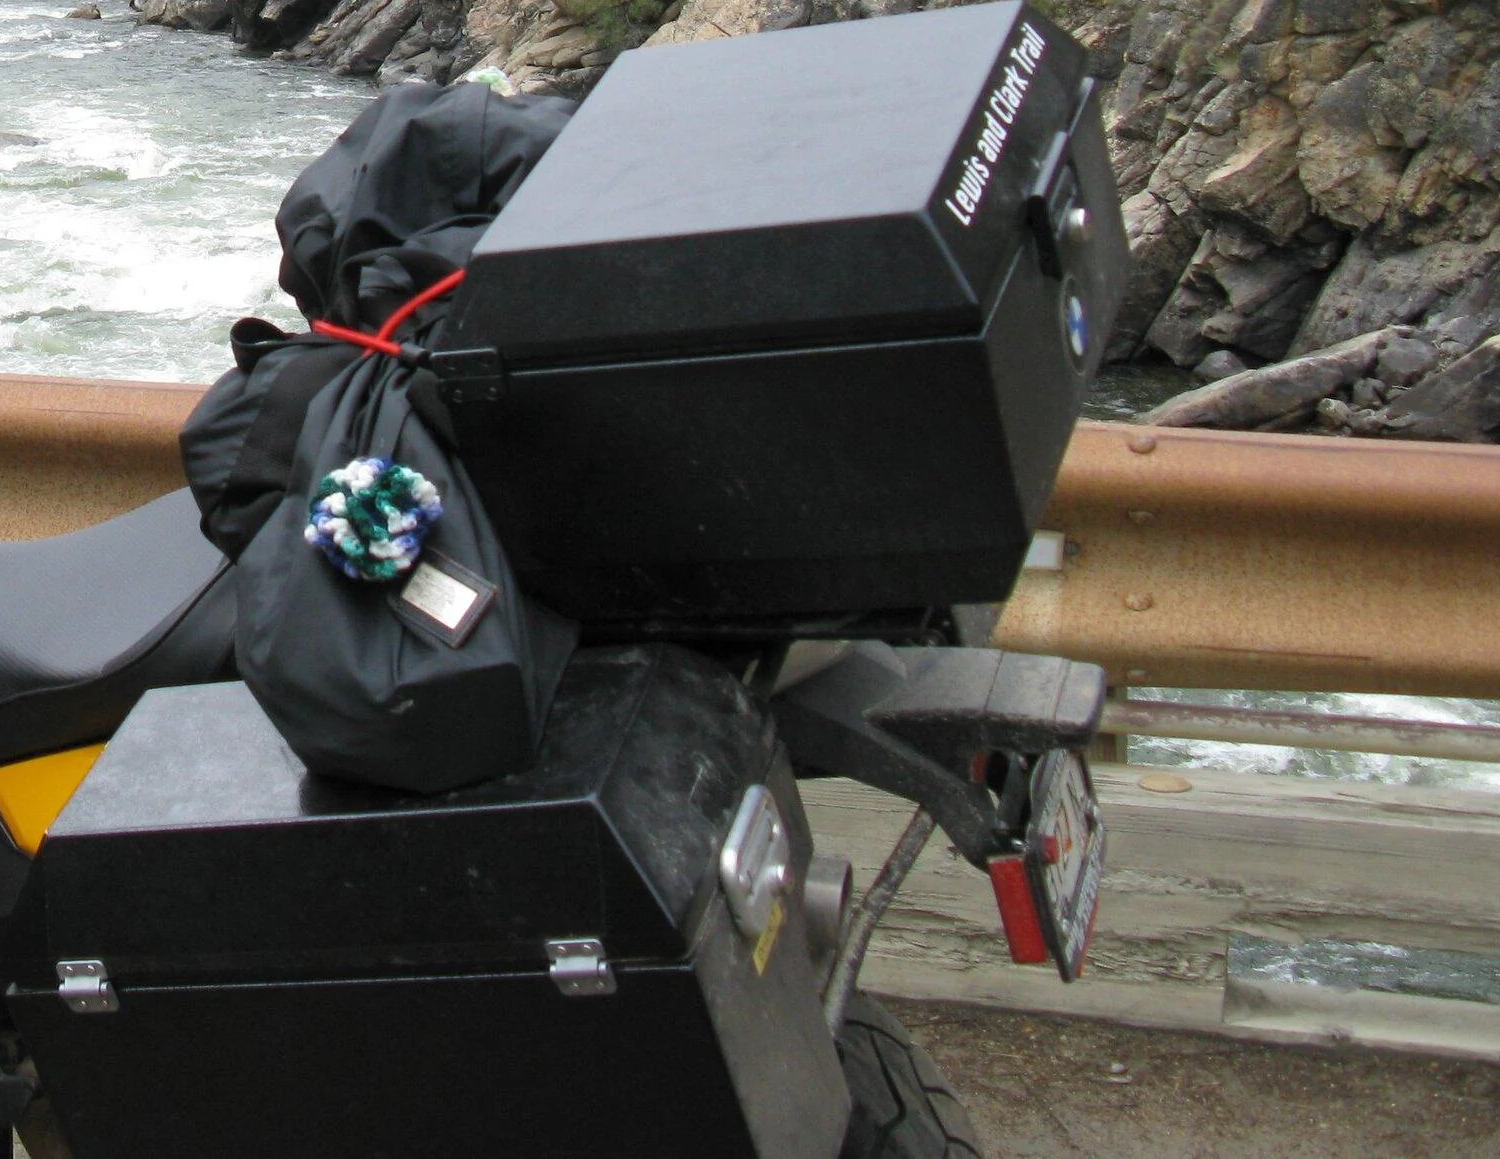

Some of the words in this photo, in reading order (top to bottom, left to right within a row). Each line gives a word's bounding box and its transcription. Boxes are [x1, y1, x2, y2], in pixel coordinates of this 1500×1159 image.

[1010, 22, 1046, 75] Trail
[990, 66, 1029, 125] Clark
[977, 111, 1007, 163] and
[945, 156, 990, 226] Lewis
